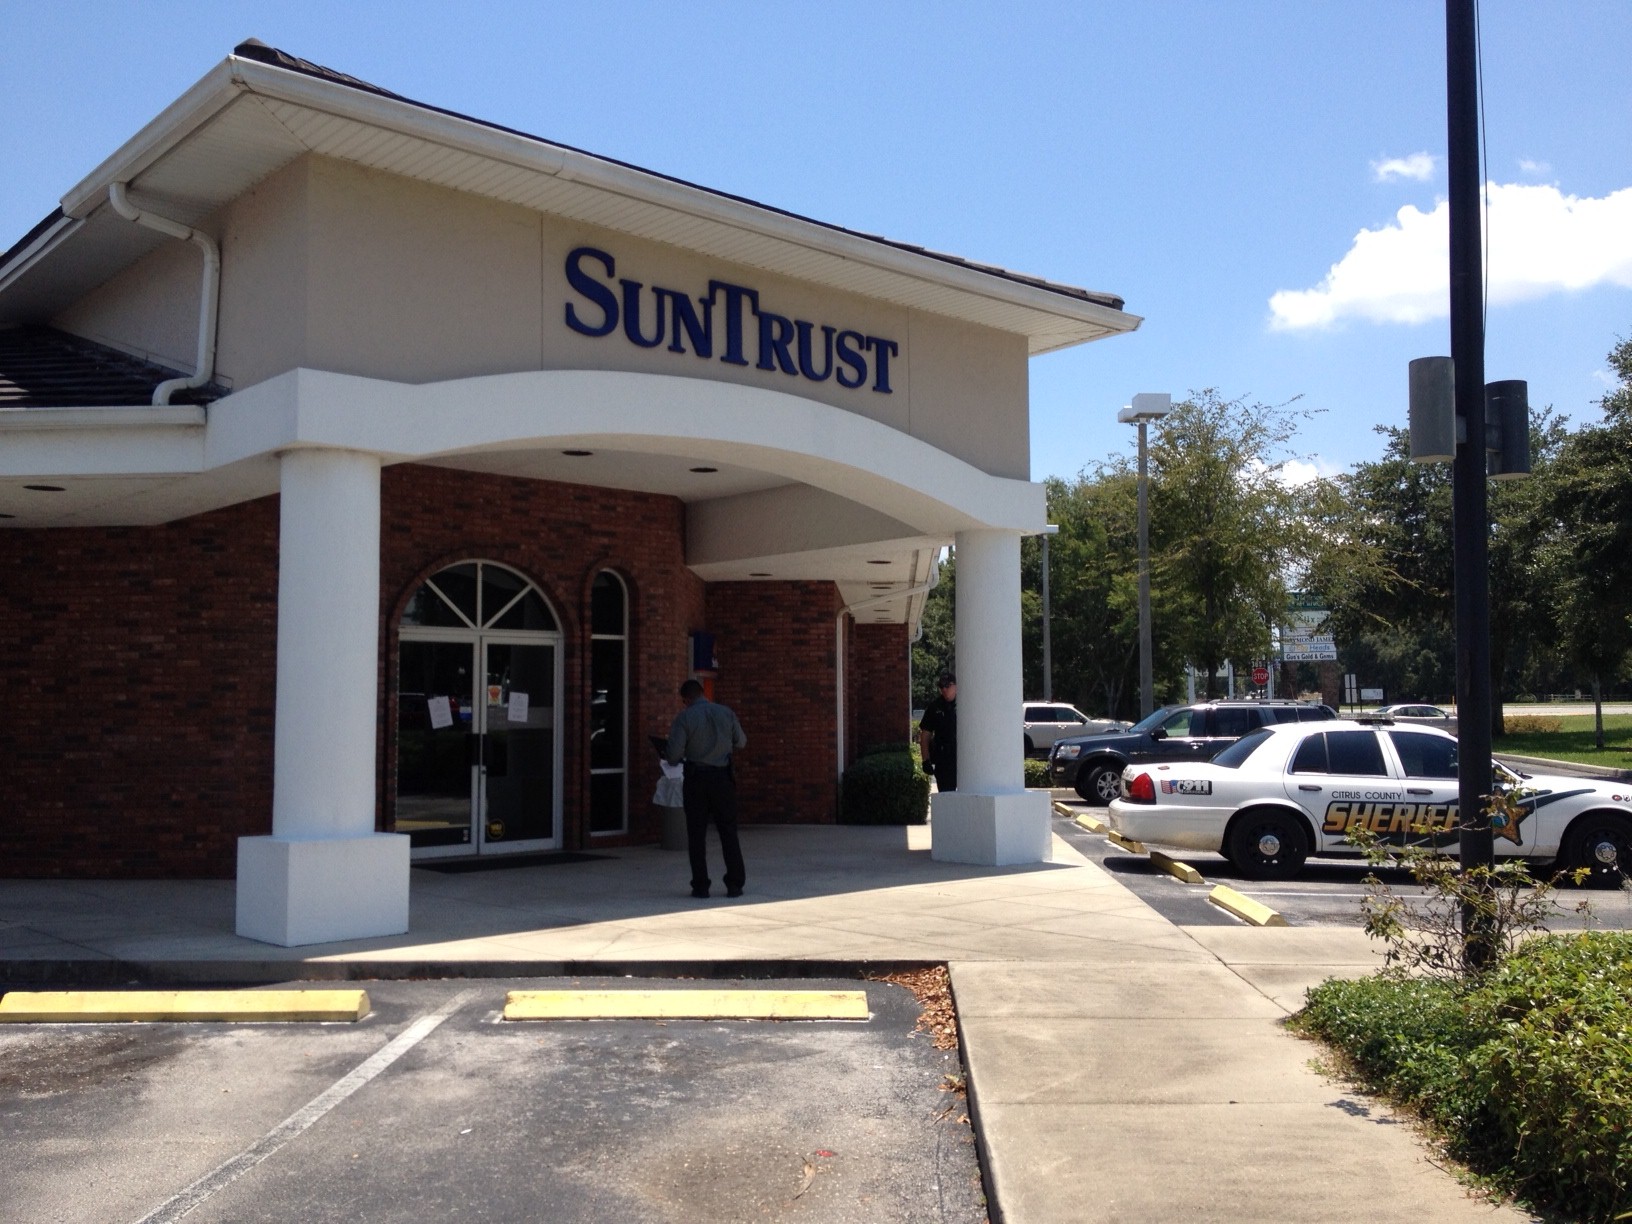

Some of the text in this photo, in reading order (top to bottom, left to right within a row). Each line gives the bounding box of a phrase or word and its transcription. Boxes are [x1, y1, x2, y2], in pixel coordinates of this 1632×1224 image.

[565, 247, 898, 393] SUNTRUST
[1331, 790, 1402, 800] CITRUS COUNTY
